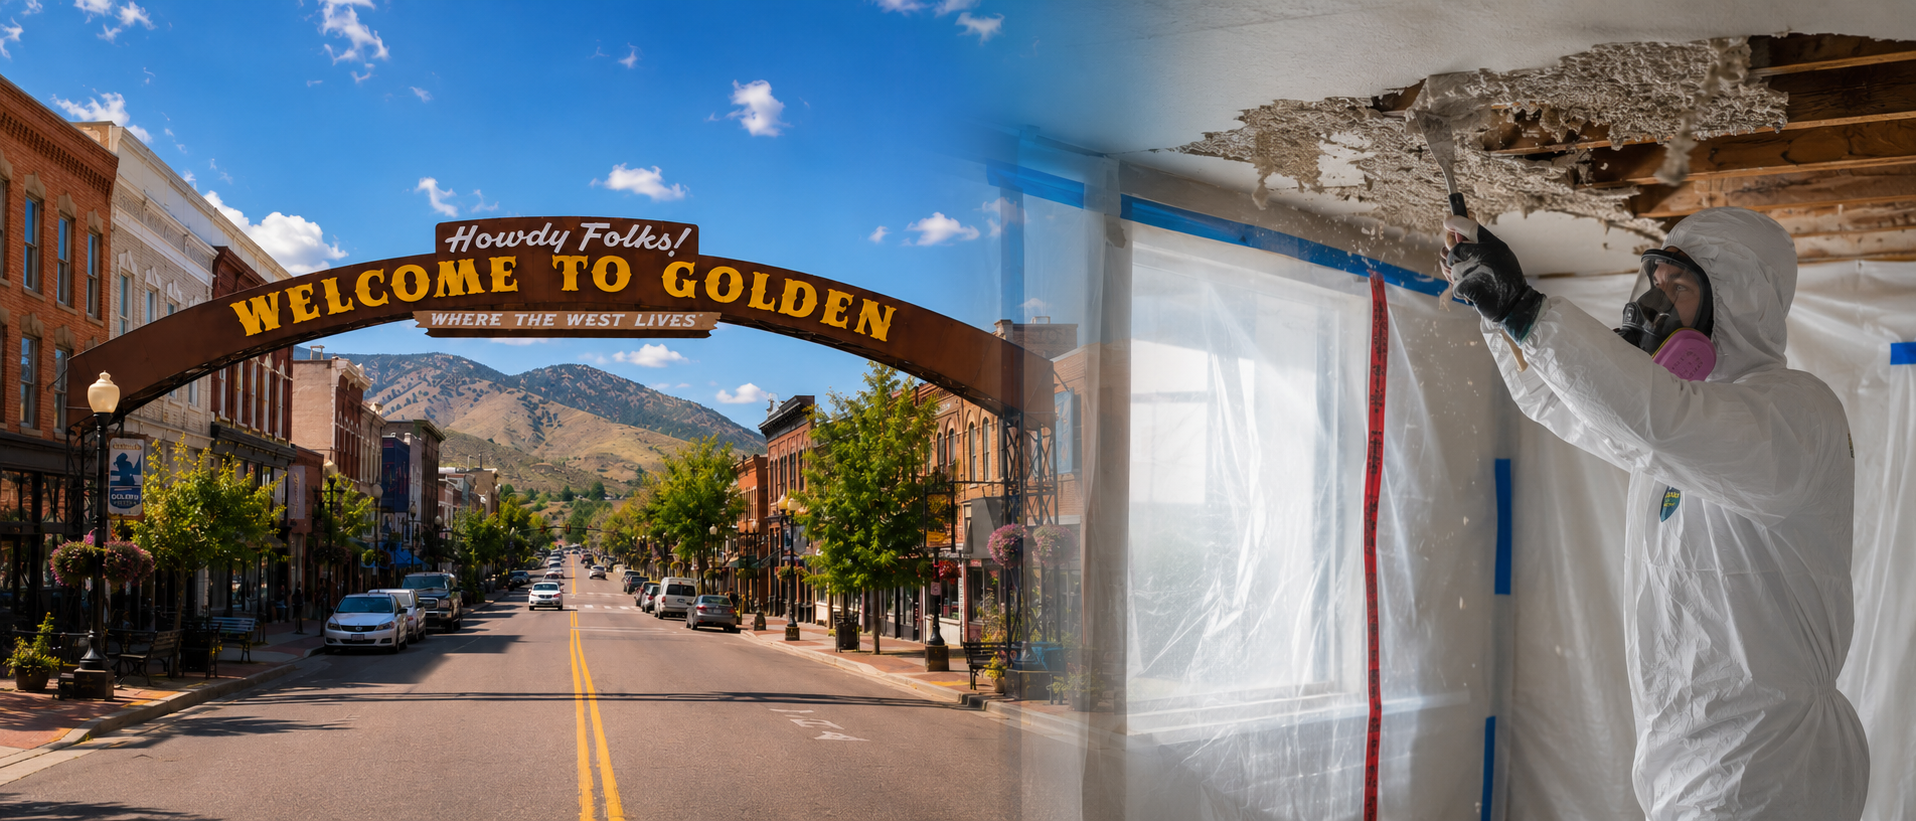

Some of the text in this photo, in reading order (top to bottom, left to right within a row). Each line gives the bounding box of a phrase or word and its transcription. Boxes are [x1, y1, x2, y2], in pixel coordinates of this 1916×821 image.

[445, 222, 692, 257] Howdy Folks!
[229, 255, 897, 342] WELCOME TO GOLDEN
[431, 313, 503, 326] WHERE
[514, 313, 557, 326] THE
[567, 313, 625, 326] WEST
